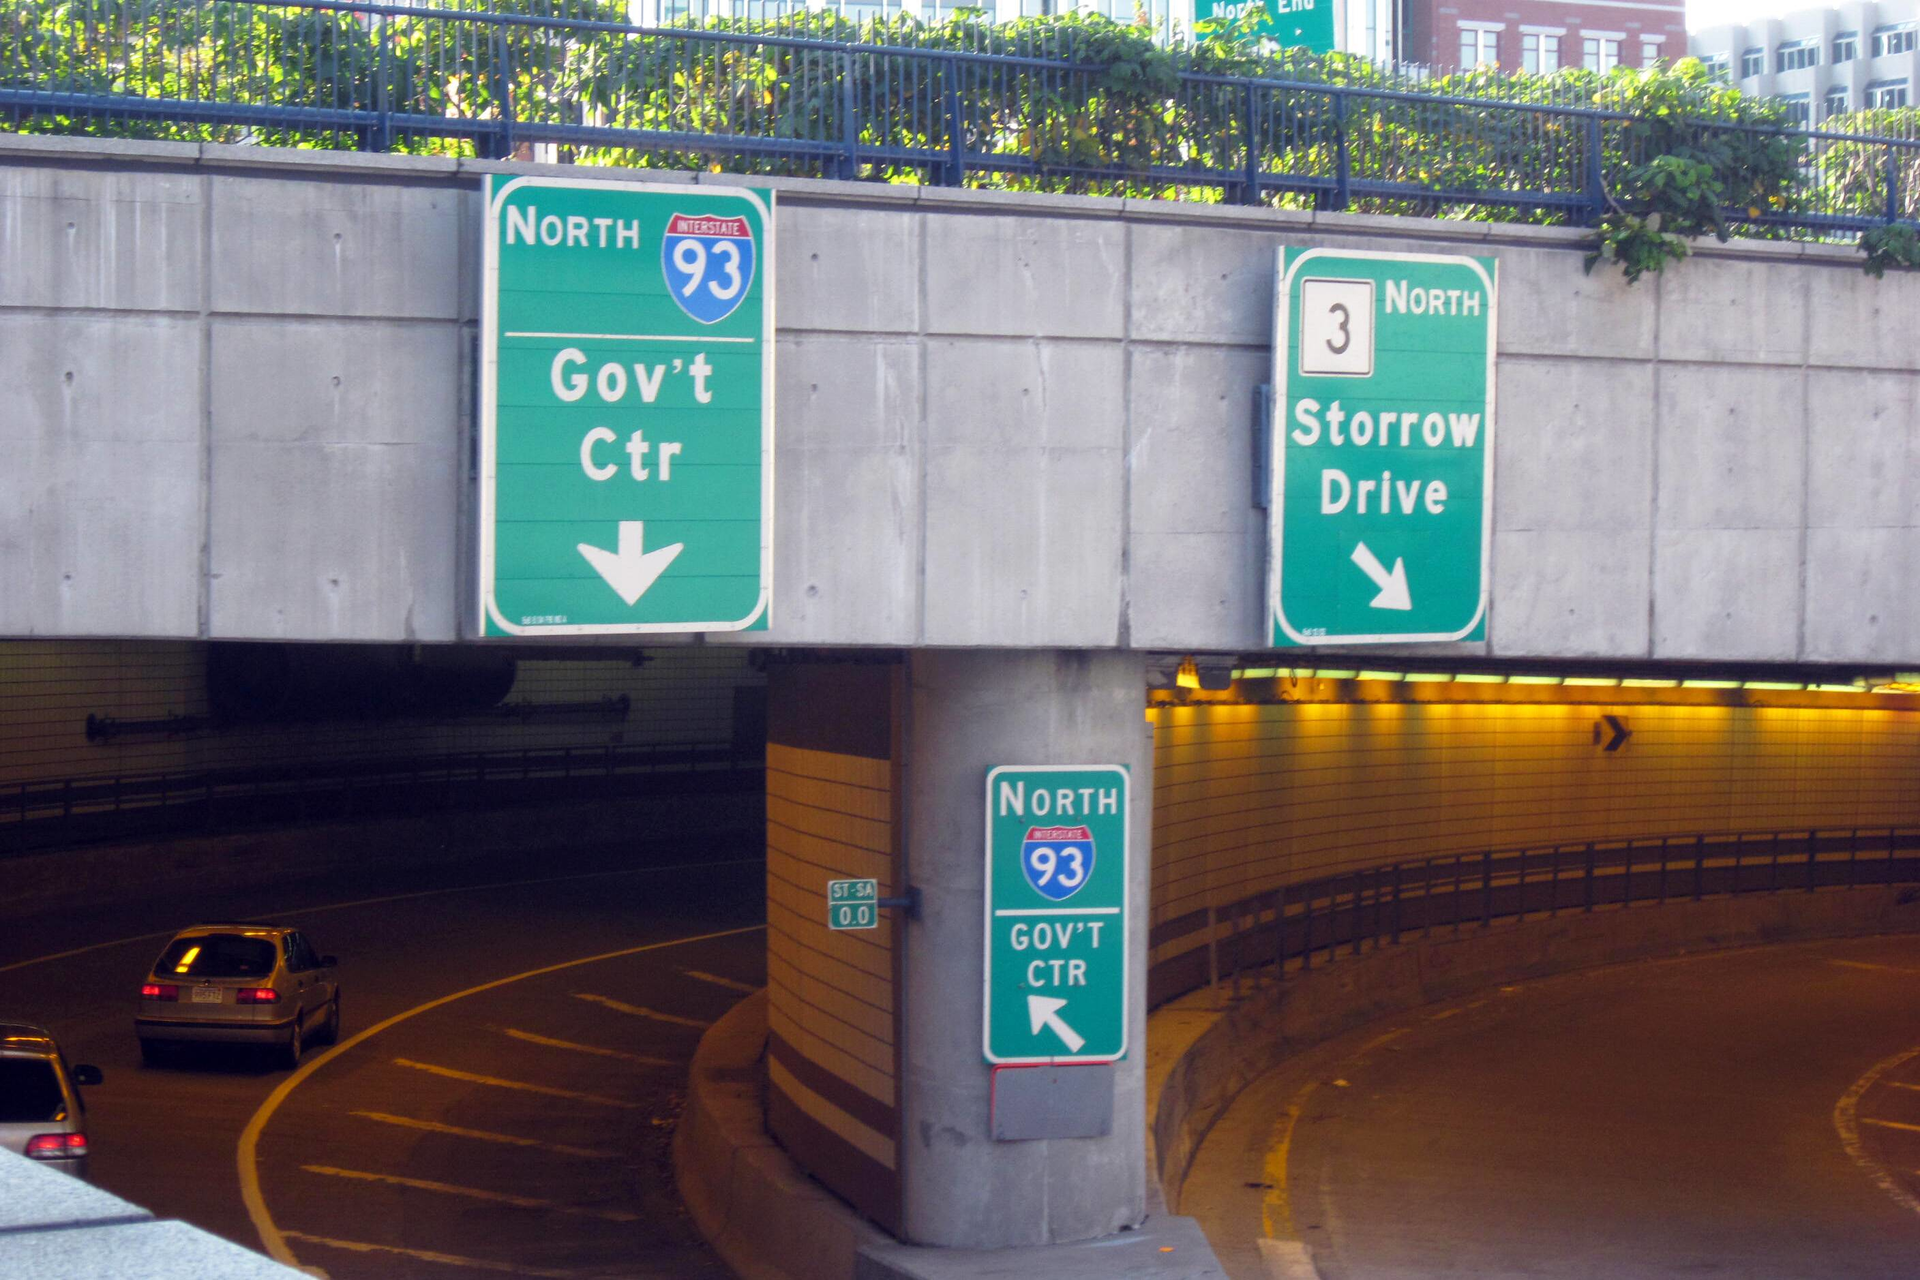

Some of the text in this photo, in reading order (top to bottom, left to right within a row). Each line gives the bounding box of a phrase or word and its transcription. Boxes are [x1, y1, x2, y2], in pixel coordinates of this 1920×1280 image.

[505, 204, 640, 249] NORTH
[677, 219, 740, 236] INTERSTATE
[672, 238, 742, 300] 93
[1384, 279, 1481, 317] NORTH
[1325, 302, 1351, 355] 3
[550, 347, 713, 404] Gov't
[1291, 397, 1481, 447] Storrow
[579, 426, 683, 481] Ctr
[1320, 468, 1448, 516] Drive
[1000, 781, 1118, 816] NORTH
[1032, 828, 1085, 840] INTERSTATE
[1030, 846, 1085, 888] 93
[833, 883, 874, 898] ST-SA
[839, 906, 870, 926] 0.0
[1010, 921, 1105, 951] GOV'T
[1026, 959, 1087, 987] CTR
